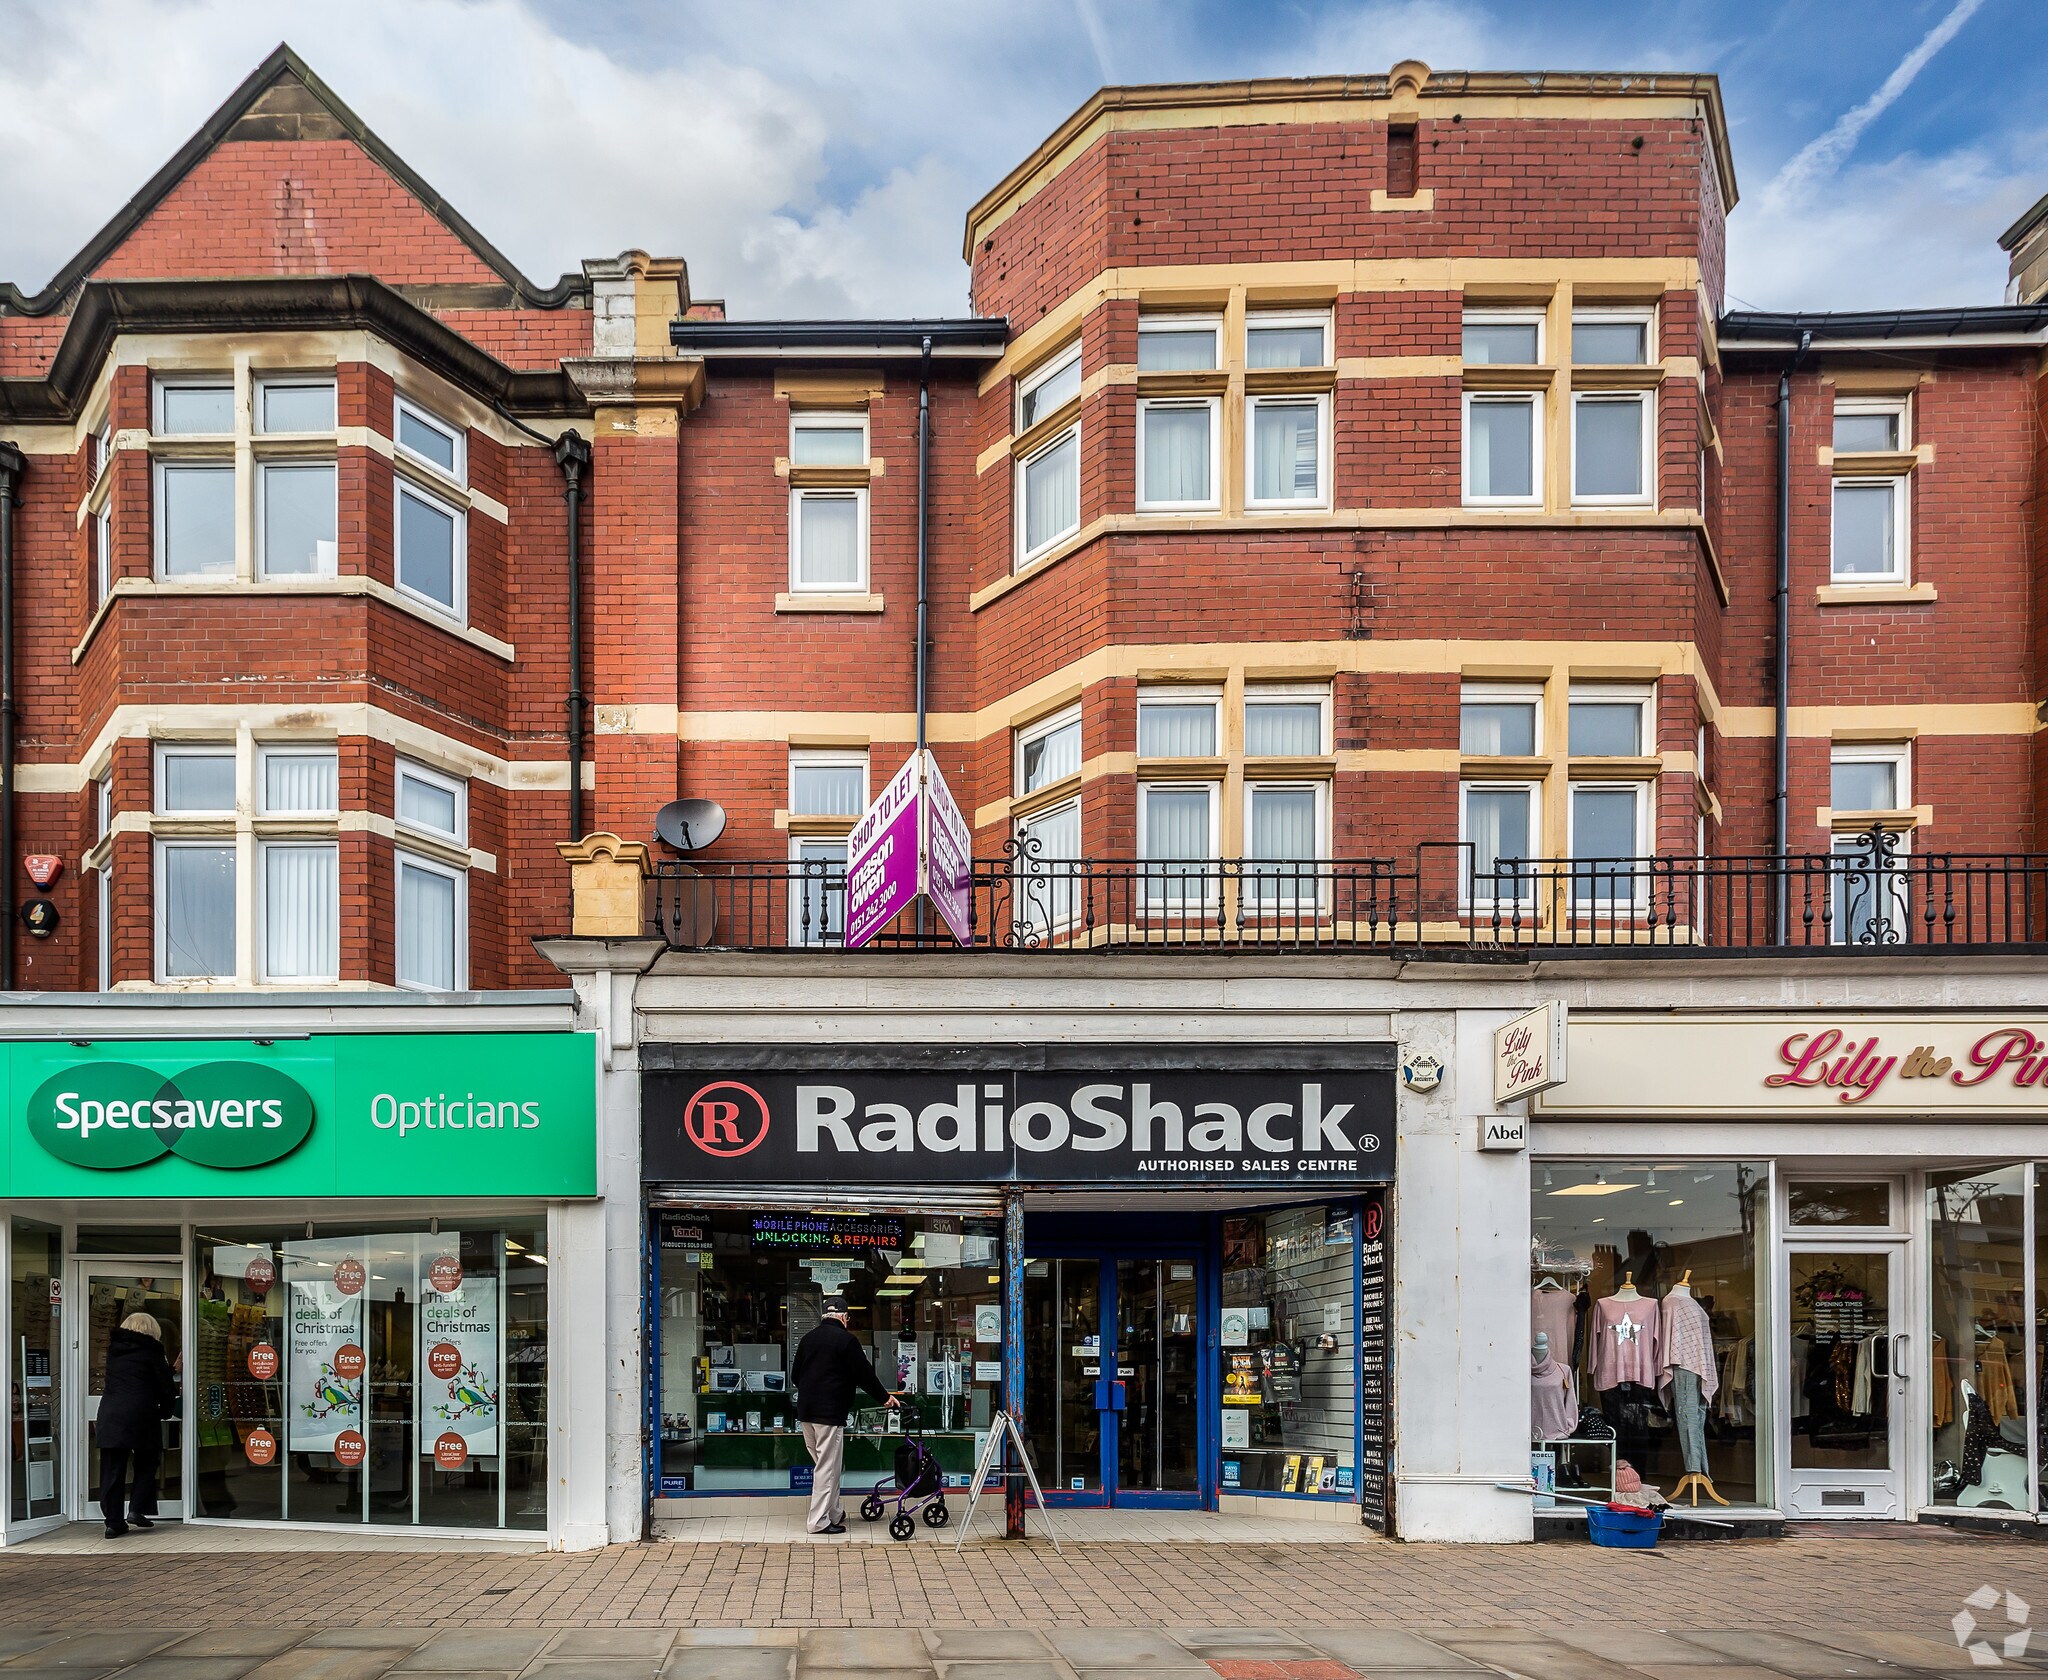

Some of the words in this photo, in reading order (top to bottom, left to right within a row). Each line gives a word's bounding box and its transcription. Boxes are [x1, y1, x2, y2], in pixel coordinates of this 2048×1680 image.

[852, 816, 876, 858] SHOP
[880, 792, 891, 825] TO
[894, 767, 912, 809] LET
[932, 770, 949, 814] SHOP
[959, 822, 969, 858] LET
[932, 812, 960, 878] mason
[851, 834, 894, 895] mason
[932, 834, 956, 889] owen
[851, 865, 886, 913] owen
[850, 913, 866, 935] 0151
[866, 899, 879, 921] 242
[879, 880, 897, 906] 3000
[1501, 1027, 1532, 1058] Lily
[1410, 1055, 1422, 1068] RED
[1427, 1055, 1440, 1069] ROSE
[1507, 1055, 1517, 1067] the
[1764, 1028, 1898, 1103] Lily
[1900, 1045, 1952, 1078] the
[1507, 1055, 1544, 1089] Pink
[55, 1092, 283, 1138] Specsavers
[371, 1092, 540, 1137] Opticians
[796, 1083, 1357, 1152] RadioShack
[1487, 1125, 1523, 1140] Abel
[1137, 1160, 1235, 1171] AUTHORISED
[1241, 1159, 1290, 1171] SALES
[1297, 1159, 1358, 1171] CENTRE
[661, 1213, 710, 1221] RadioShack
[671, 1225, 703, 1240] Tandy
[755, 1219, 792, 1230] MOBILE
[794, 1221, 828, 1231] PHONE
[830, 1223, 900, 1234] ACCESSORIES
[933, 1224, 952, 1233] SIM
[832, 1234, 842, 1245] &
[844, 1235, 897, 1246] REPAIRS
[1363, 1240, 1383, 1254] Radio
[1363, 1252, 1383, 1267] Shack
[250, 1267, 272, 1276] Free
[339, 1270, 361, 1279] Free
[434, 1265, 458, 1274] Free
[812, 1274, 828, 1283] Only
[1362, 1275, 1384, 1287] SCANNERS
[295, 1294, 317, 1306] The
[427, 1292, 450, 1303] The
[1363, 1291, 1383, 1301] MOBILE
[1363, 1298, 1384, 1309] PHONES
[295, 1308, 326, 1320] deals
[329, 1307, 342, 1320] of
[427, 1306, 459, 1318] deals
[462, 1306, 476, 1318] of
[295, 1322, 355, 1334] Christmas
[427, 1321, 490, 1333] Christmas
[252, 1352, 274, 1360] Free
[338, 1355, 361, 1363] Free
[433, 1353, 457, 1361] Free
[250, 1438, 272, 1447] Free
[339, 1440, 361, 1449] Free
[439, 1441, 462, 1450] Free
